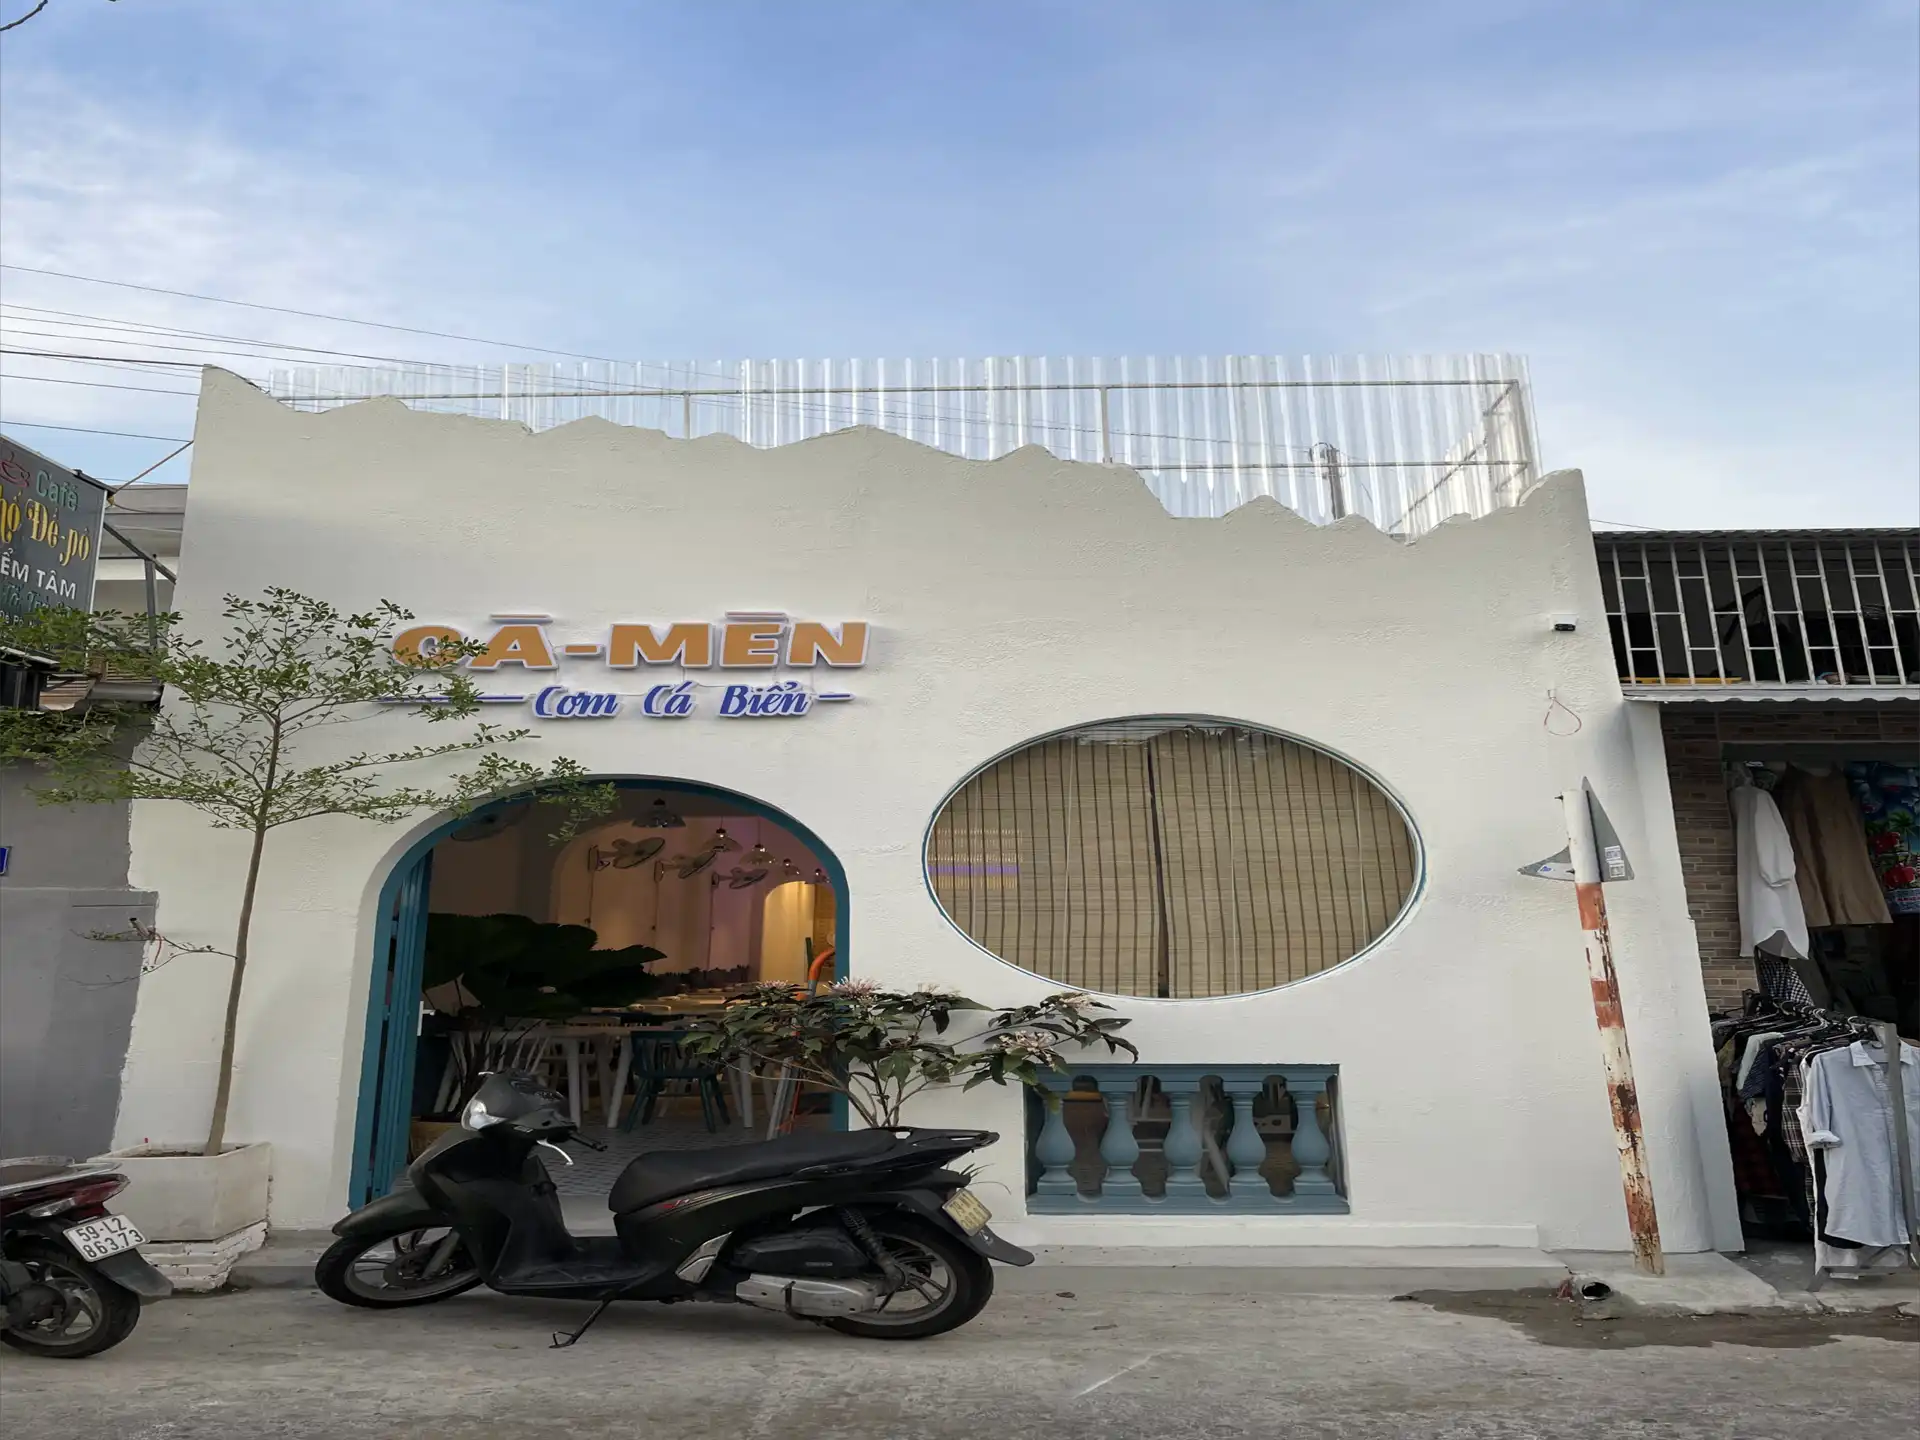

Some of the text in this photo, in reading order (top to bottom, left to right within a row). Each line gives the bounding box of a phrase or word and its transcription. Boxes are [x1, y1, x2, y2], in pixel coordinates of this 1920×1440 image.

[36, 569, 76, 600] TÂM
[643, 681, 693, 716] Cá
[719, 681, 809, 716] Biển
[76, 1217, 127, 1242] 59-L2
[83, 1229, 143, 1258] 863.73
